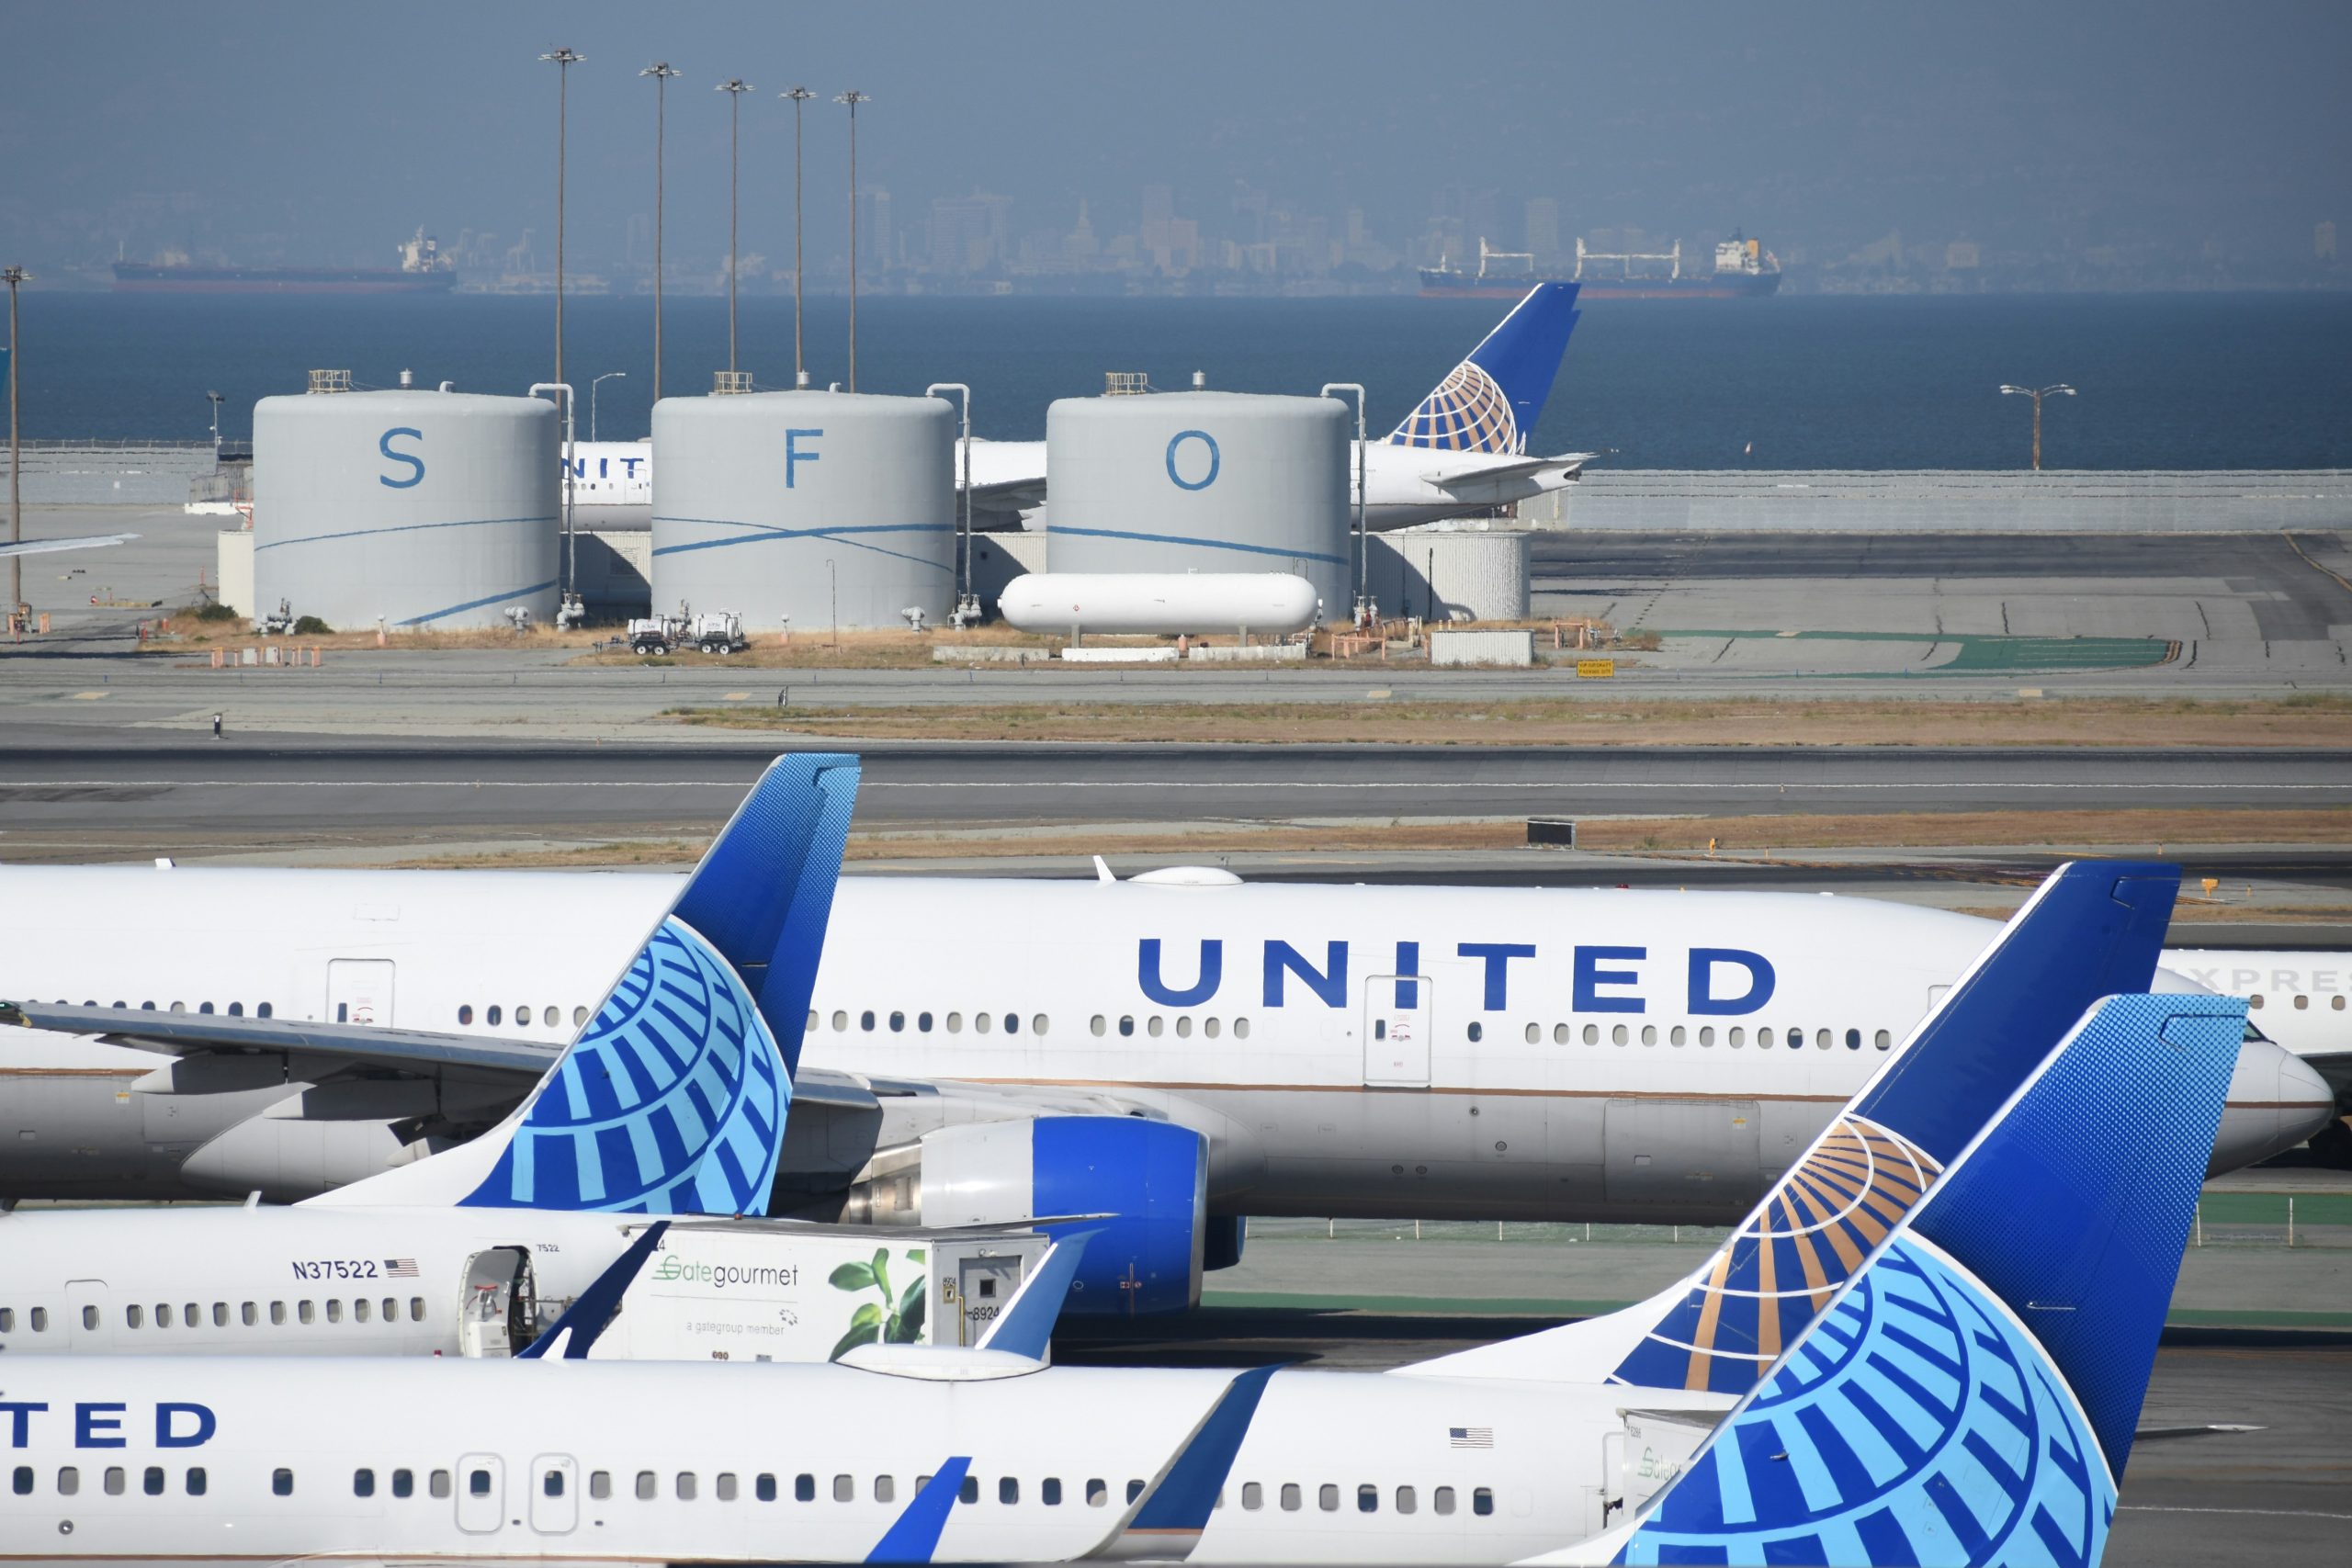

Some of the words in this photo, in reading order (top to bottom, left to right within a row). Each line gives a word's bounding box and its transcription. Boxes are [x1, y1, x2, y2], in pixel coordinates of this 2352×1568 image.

[379, 427, 426, 489] S
[786, 429, 824, 489] F
[1166, 431, 1220, 491] O
[1138, 938, 1776, 1016] UNITED
[2167, 968, 2352, 992] XPRE
[536, 1244, 560, 1253] 7522
[292, 1259, 379, 1280] N37522
[942, 1276, 956, 1287] 8924
[685, 1322, 693, 1331] a
[695, 1322, 743, 1336] gategroup
[746, 1324, 786, 1336] member
[0, 1402, 217, 1449] TED
